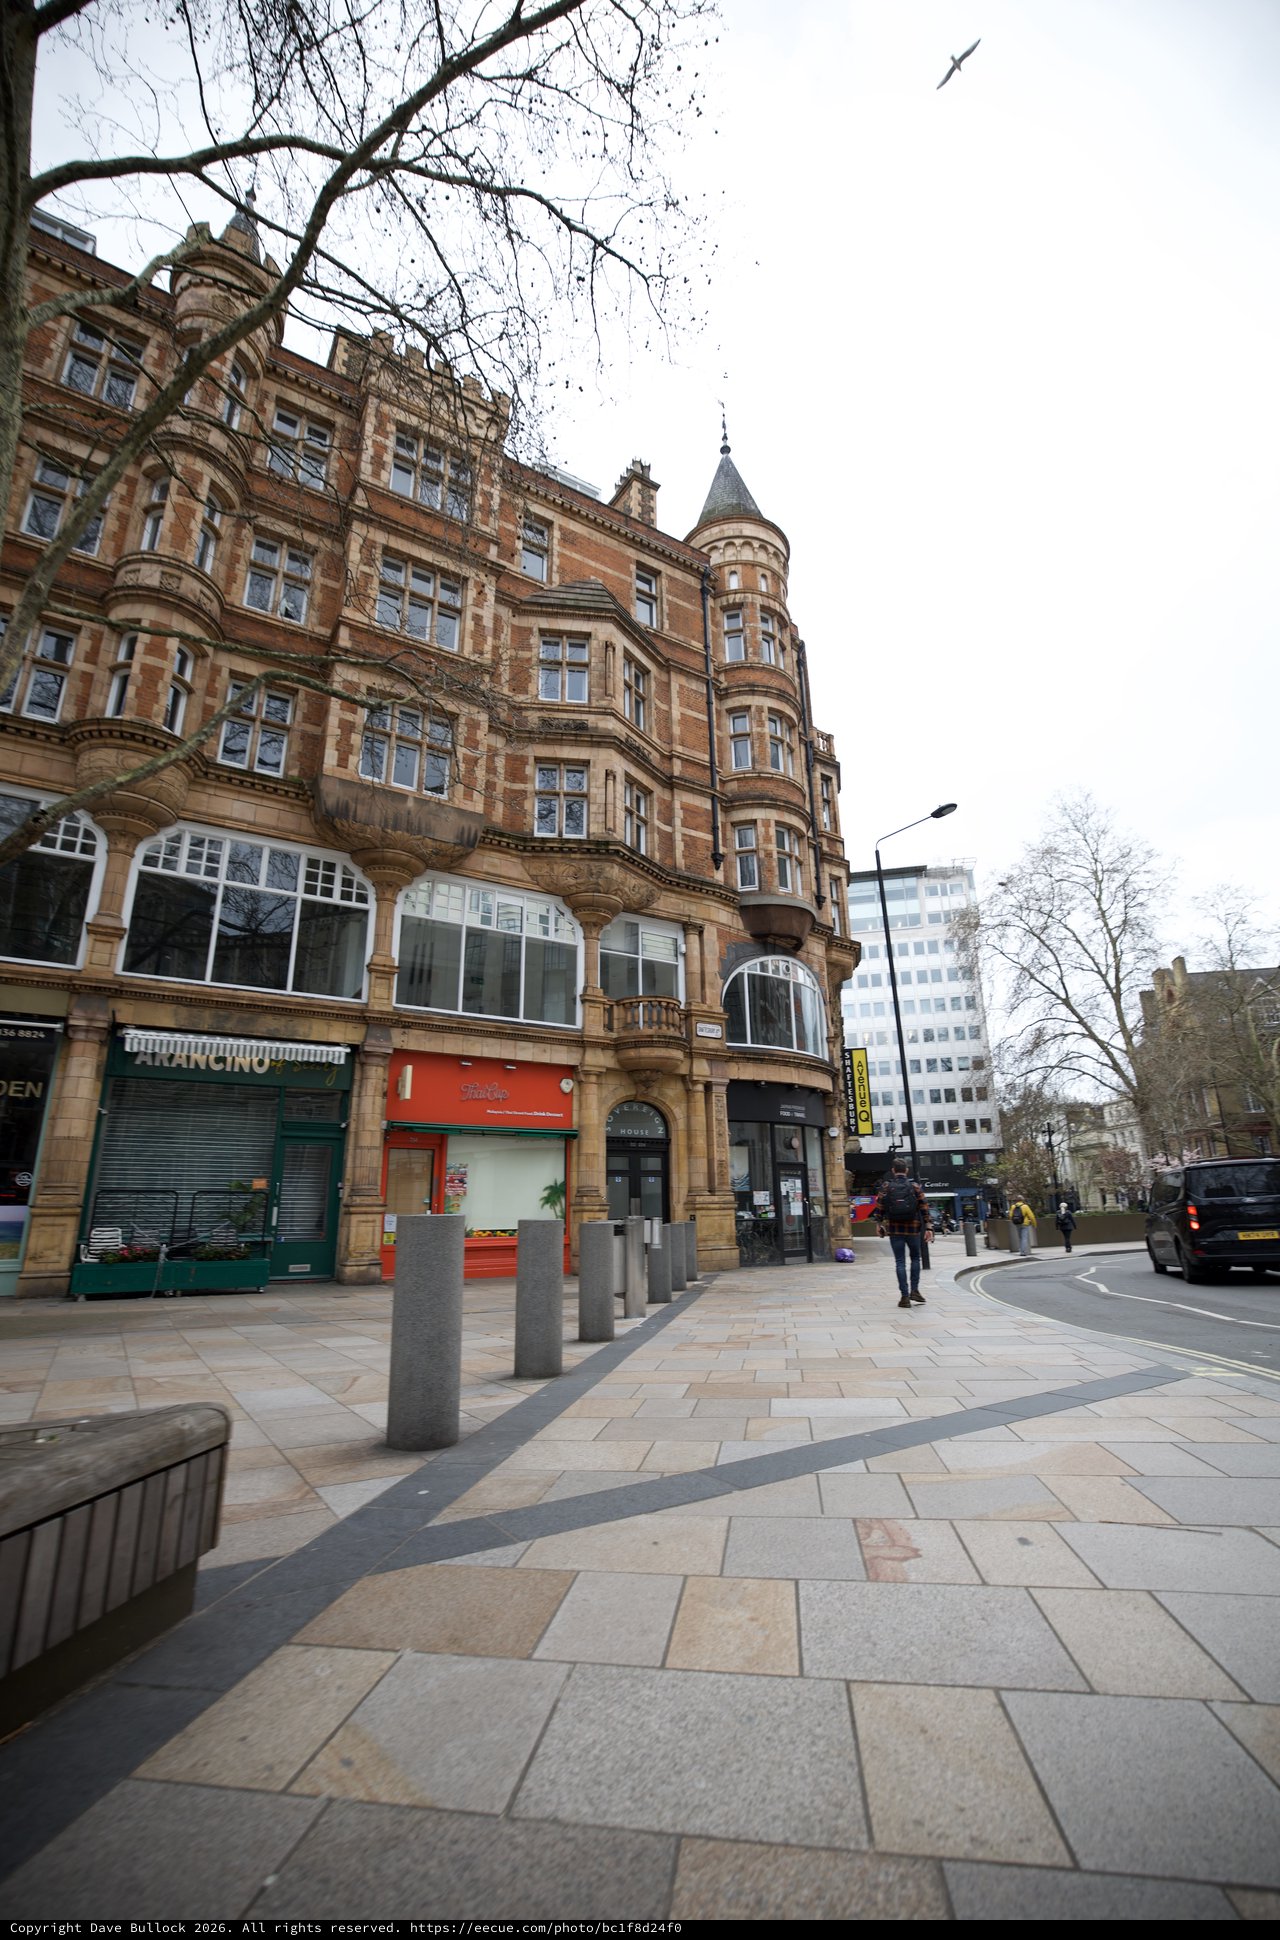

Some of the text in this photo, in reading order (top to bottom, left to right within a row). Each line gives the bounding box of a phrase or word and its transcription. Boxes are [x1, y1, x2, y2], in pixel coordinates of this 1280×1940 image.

[17, 1030, 45, 1038] 8824
[135, 1052, 270, 1074] ARANCINO
[844, 1052, 856, 1132] SHAFTESBURY
[857, 1060, 870, 1122] Avenue Q
[604, 1103, 664, 1134] SOVEREIGN
